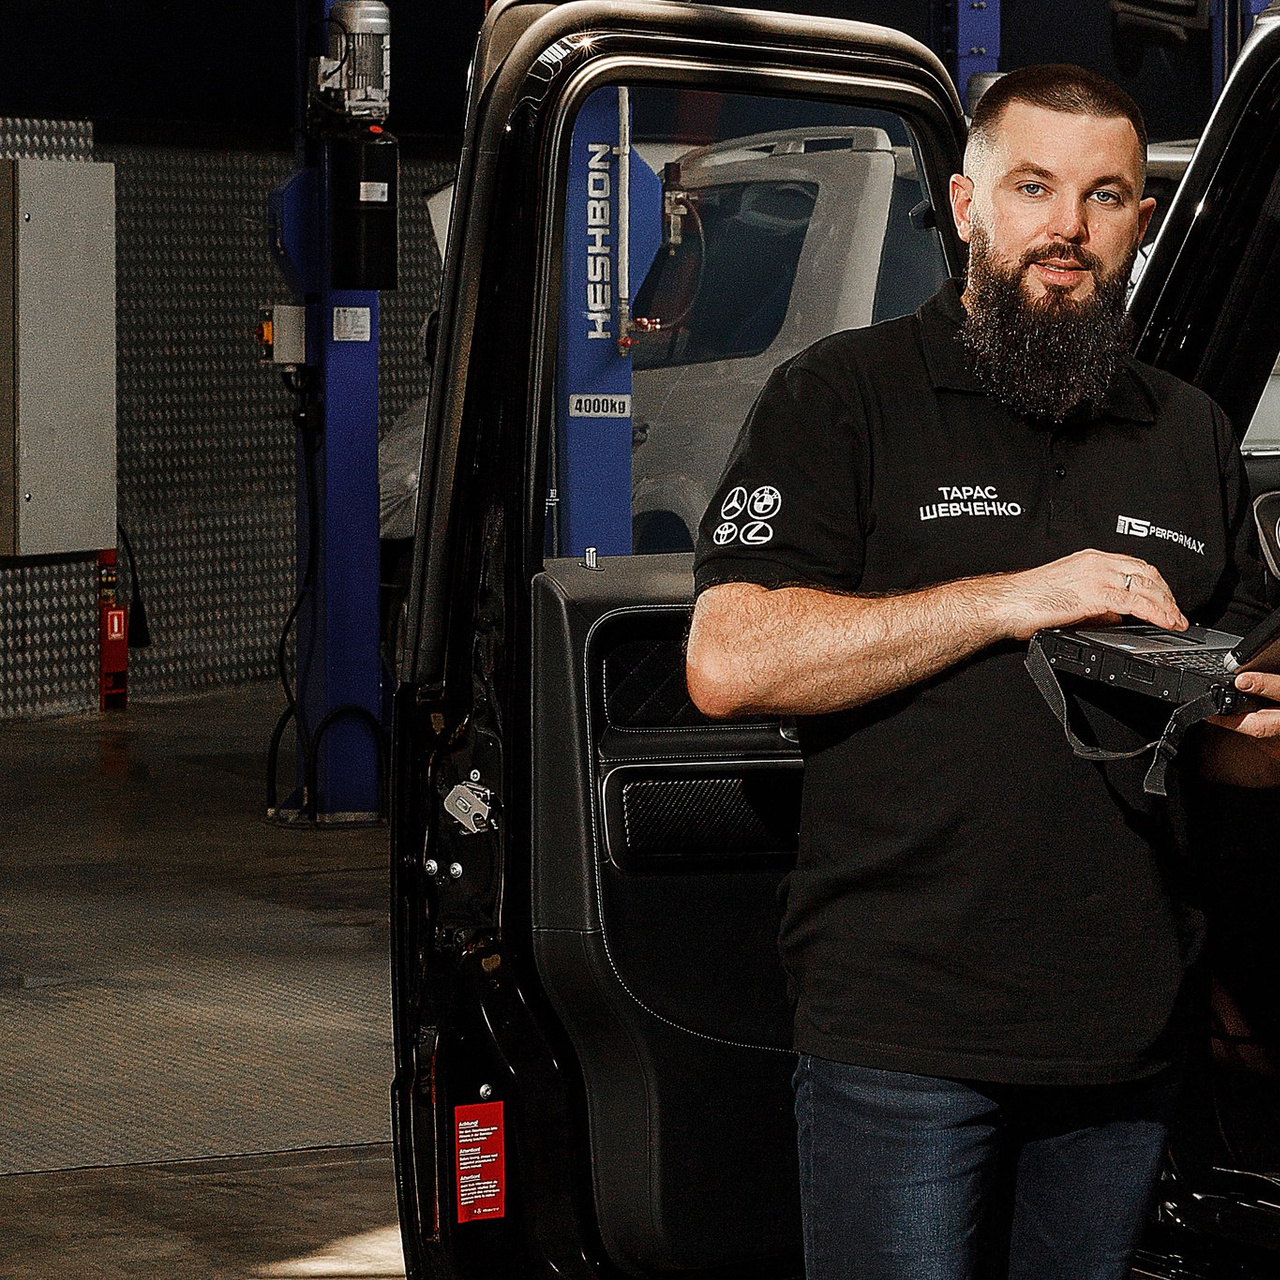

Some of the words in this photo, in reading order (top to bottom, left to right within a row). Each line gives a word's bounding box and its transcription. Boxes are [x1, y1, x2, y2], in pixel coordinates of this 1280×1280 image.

[587, 142, 613, 340] HESHBON
[574, 398, 627, 415] 4000kg
[937, 485, 999, 502] ТАРАС
[919, 502, 1022, 521] ШЕВЧЕНКО
[1149, 526, 1205, 556] PERFORMAX
